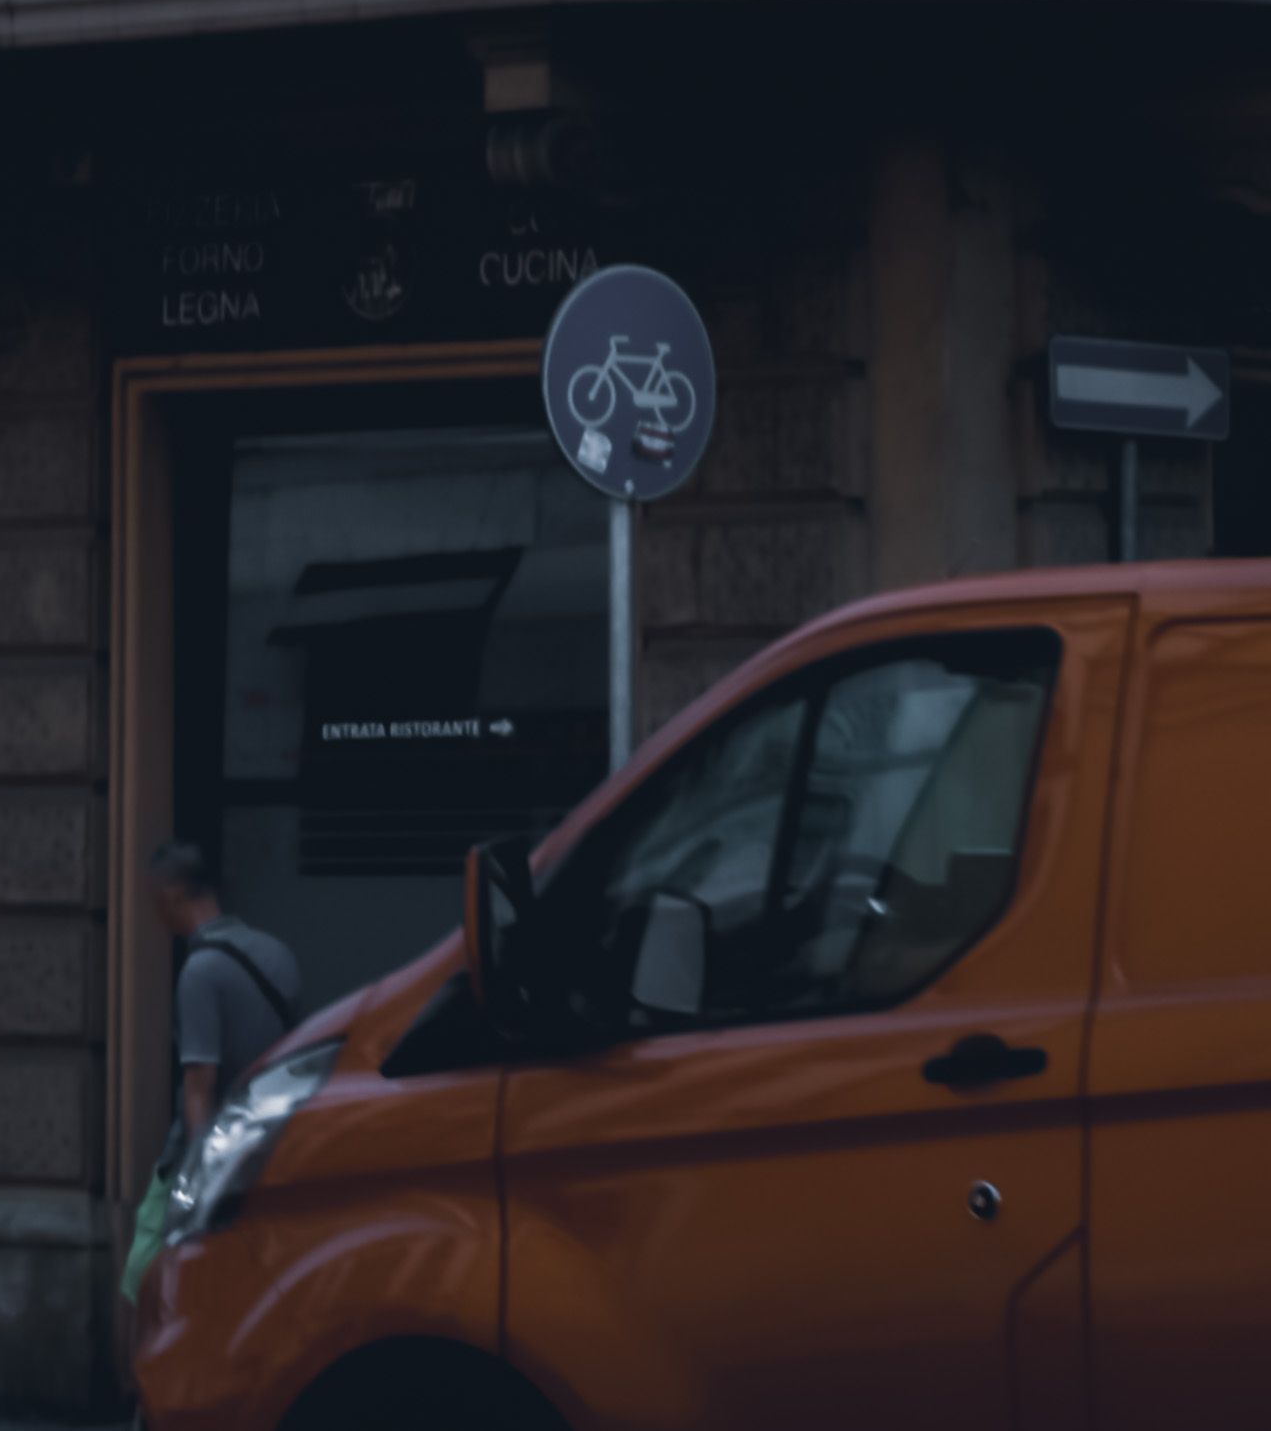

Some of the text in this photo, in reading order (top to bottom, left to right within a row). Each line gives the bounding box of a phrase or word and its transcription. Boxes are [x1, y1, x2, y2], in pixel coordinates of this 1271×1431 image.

[161, 240, 265, 275] FORNO
[161, 290, 261, 327] LEGNA
[322, 718, 480, 741] ENTRATA RISTORANTE
